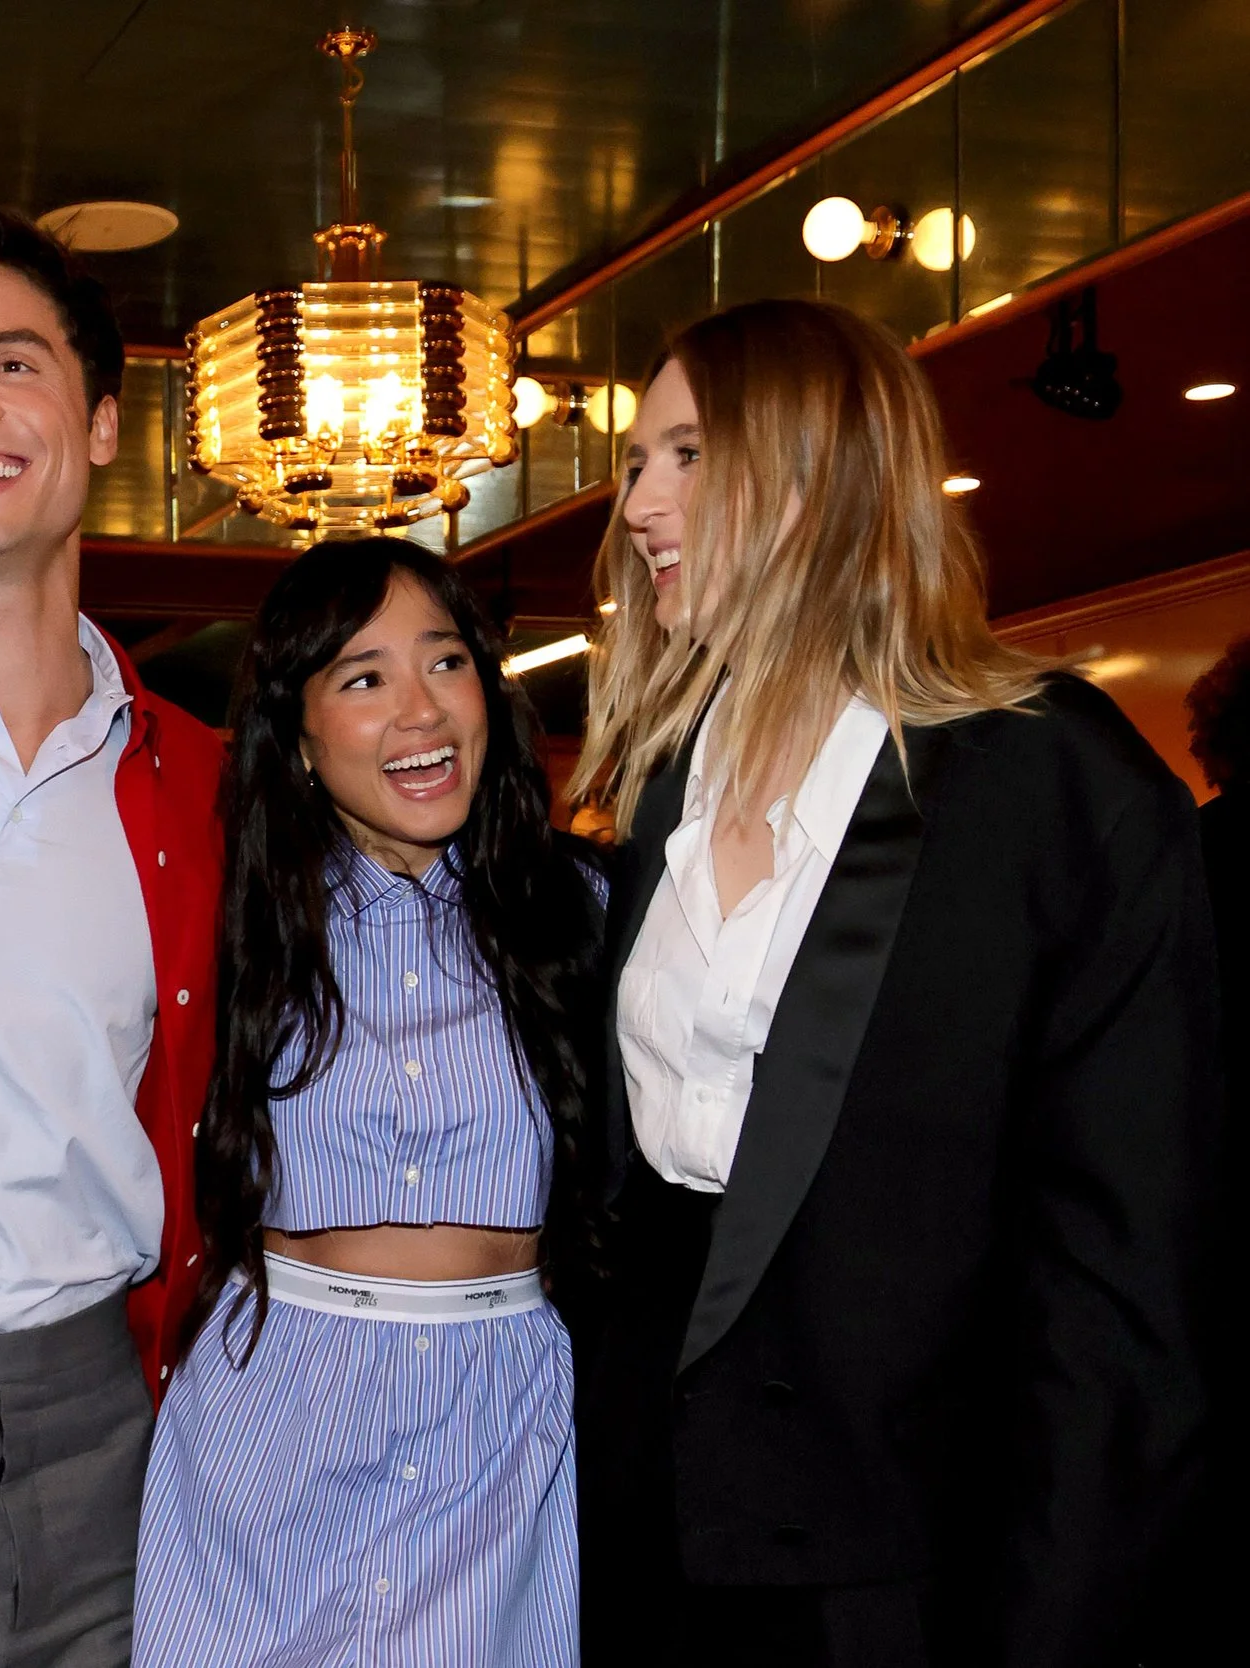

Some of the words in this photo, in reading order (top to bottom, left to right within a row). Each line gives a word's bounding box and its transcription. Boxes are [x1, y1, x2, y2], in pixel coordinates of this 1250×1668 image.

[328, 1285, 371, 1297] HOMME
[465, 1289, 502, 1300] HOMME
[353, 1294, 378, 1308] girls
